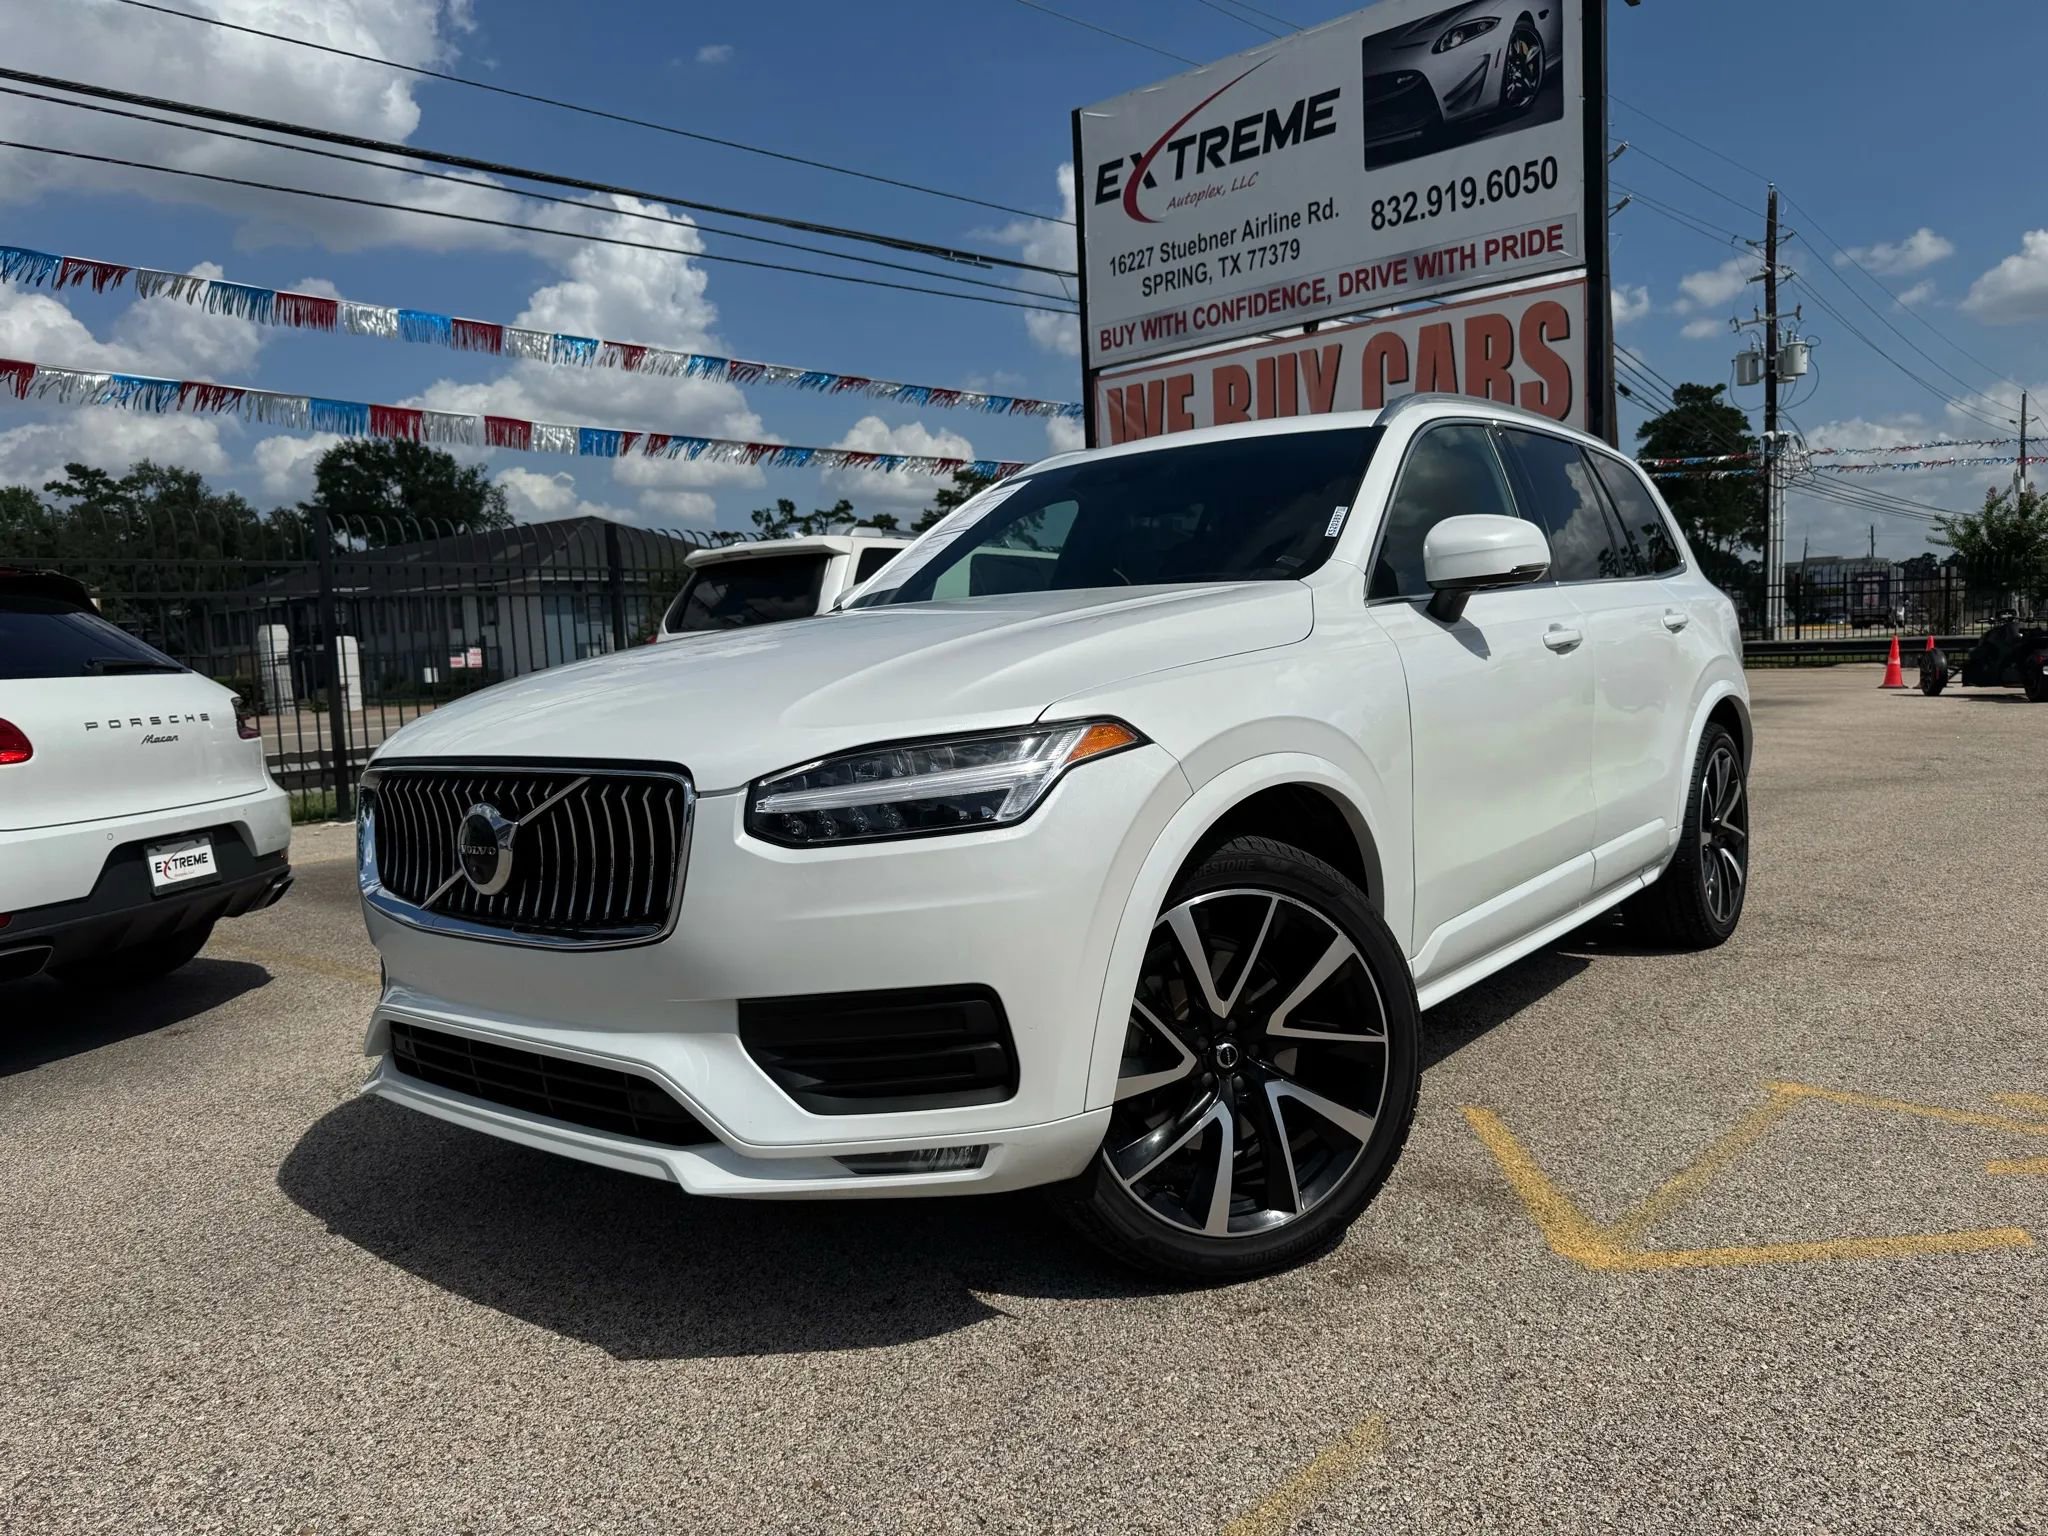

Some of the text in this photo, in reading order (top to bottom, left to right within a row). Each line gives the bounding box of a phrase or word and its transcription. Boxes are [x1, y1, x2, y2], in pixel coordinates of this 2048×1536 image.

[1095, 87, 1341, 206] EXTREME
[1166, 172, 1259, 210] Autoplex, LLC
[1370, 155, 1558, 231] 832.919.6050
[1109, 197, 1339, 276] 16227 Stuebner Airline Rd.
[1100, 224, 1564, 351] BUY WITH CONFIDENCE, DRIVE WITH PRIDE
[1142, 238, 1300, 297] SPRING, TX 77379
[1107, 372, 1194, 446] WE
[1361, 300, 1573, 422] CARS
[84, 713, 210, 731] PORSCHE
[141, 734, 179, 745] Macan
[155, 852, 208, 874] EXTREME
[461, 844, 496, 856] VOLVO
